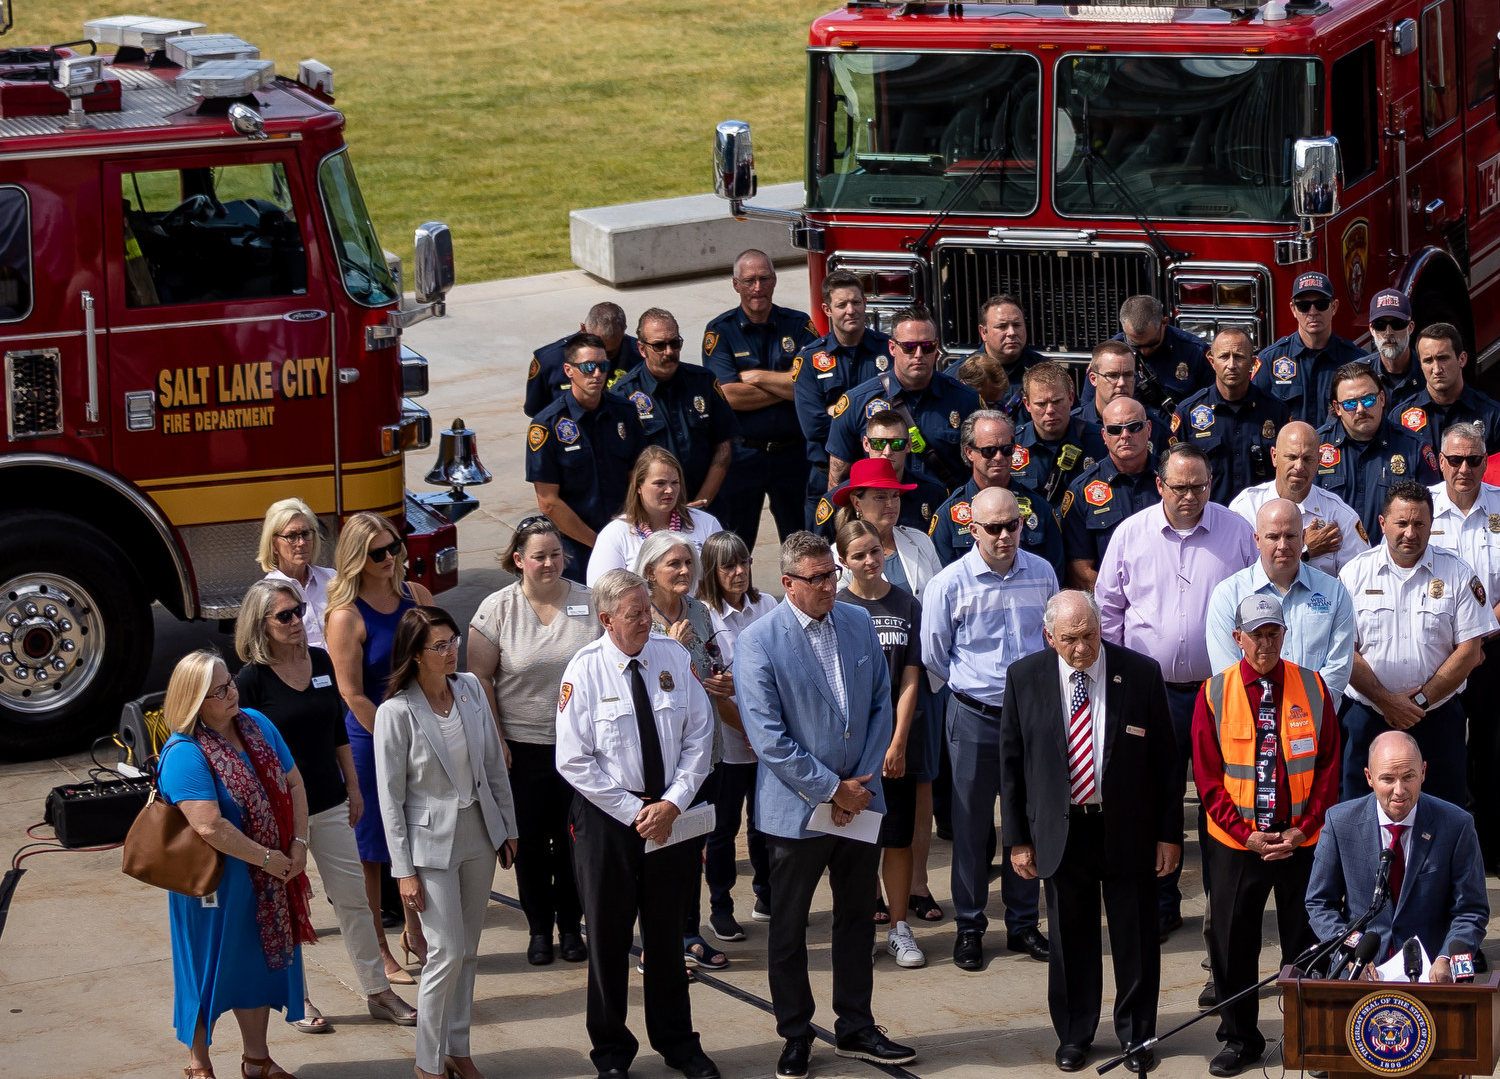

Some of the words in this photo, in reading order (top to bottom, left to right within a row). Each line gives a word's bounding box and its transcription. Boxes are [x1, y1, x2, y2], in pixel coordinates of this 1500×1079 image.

[1299, 278, 1323, 289] FIRE
[1377, 297, 1399, 308] FIRE
[157, 366, 210, 409] SALT
[217, 361, 274, 404] LAKE
[281, 356, 330, 399] CITY
[162, 412, 191, 434] FIRE
[194, 405, 275, 432] DEPARTMENT
[884, 618, 903, 626] CITY
[877, 632, 908, 646] OUNCIL
[1290, 720, 1309, 728] Mayor
[1454, 953, 1470, 961] FOX
[1454, 962, 1472, 976] 13
[1361, 1001, 1380, 1015] SEAL
[1392, 998, 1410, 1008] THE
[1409, 1006, 1426, 1027] STATE
[1355, 1015, 1364, 1041] GREAT
[1421, 1028, 1428, 1039] OF
[1356, 1041, 1368, 1058] THE
[1412, 1039, 1426, 1059] UTAH
[1380, 1061, 1402, 1069] 1896
